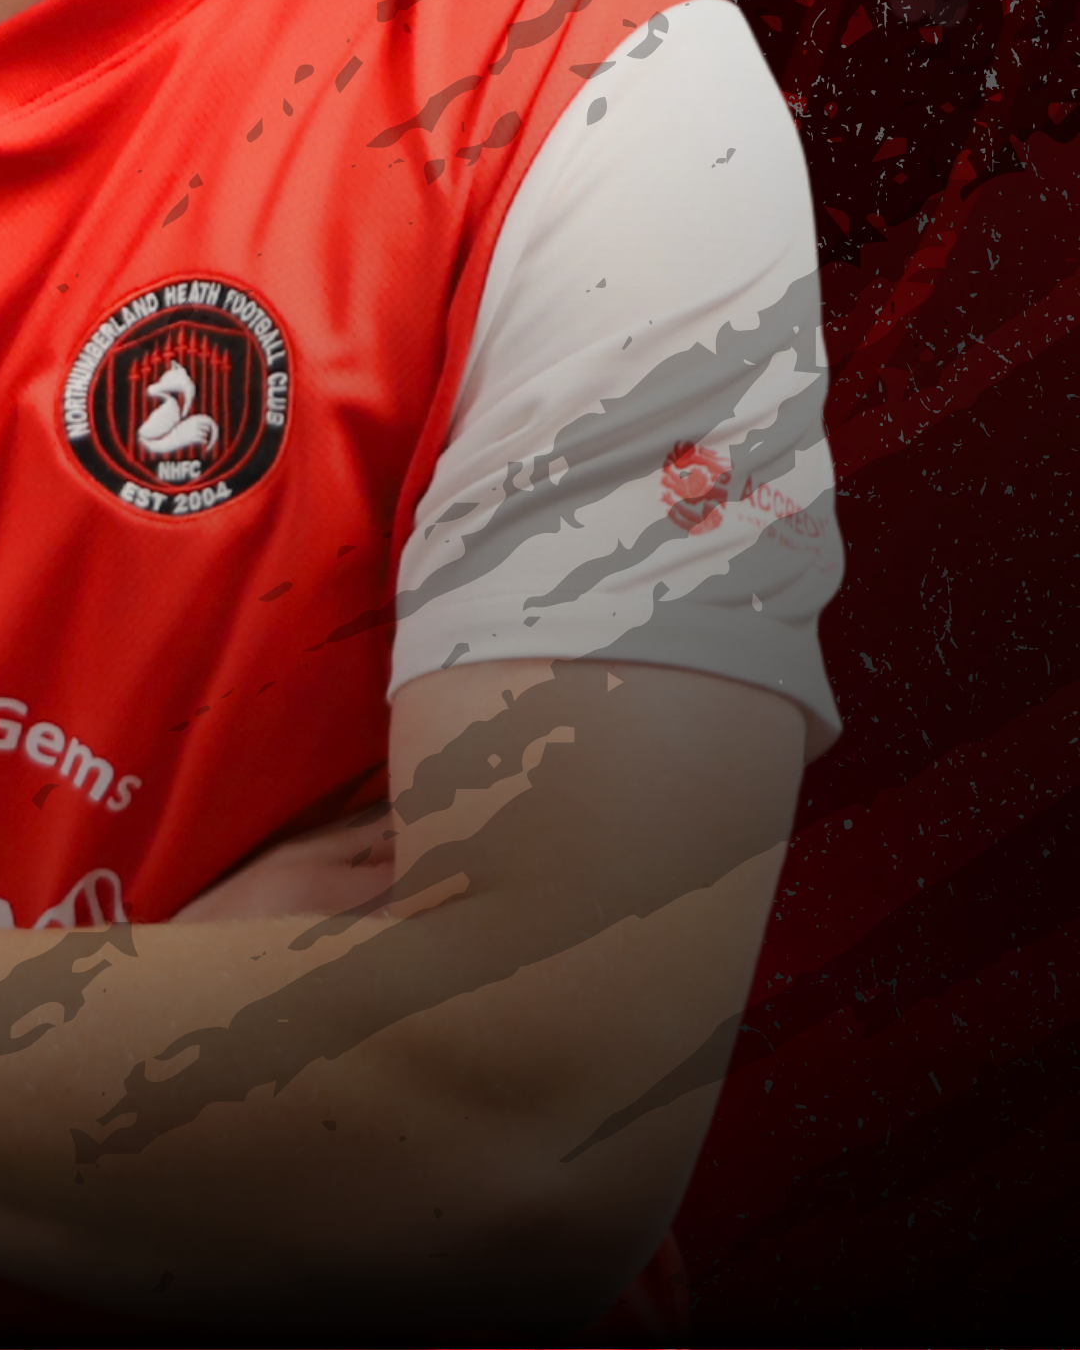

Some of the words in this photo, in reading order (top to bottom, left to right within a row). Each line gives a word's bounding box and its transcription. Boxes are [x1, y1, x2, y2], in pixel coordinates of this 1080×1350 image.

[64, 291, 159, 439] NORTHUMBERLAND
[165, 280, 221, 306] HEATH
[224, 288, 287, 366] FOOTBALL
[266, 371, 288, 426] CLUB
[158, 459, 202, 482] NHFC
[120, 481, 168, 513] EST
[172, 481, 233, 515] 2004
